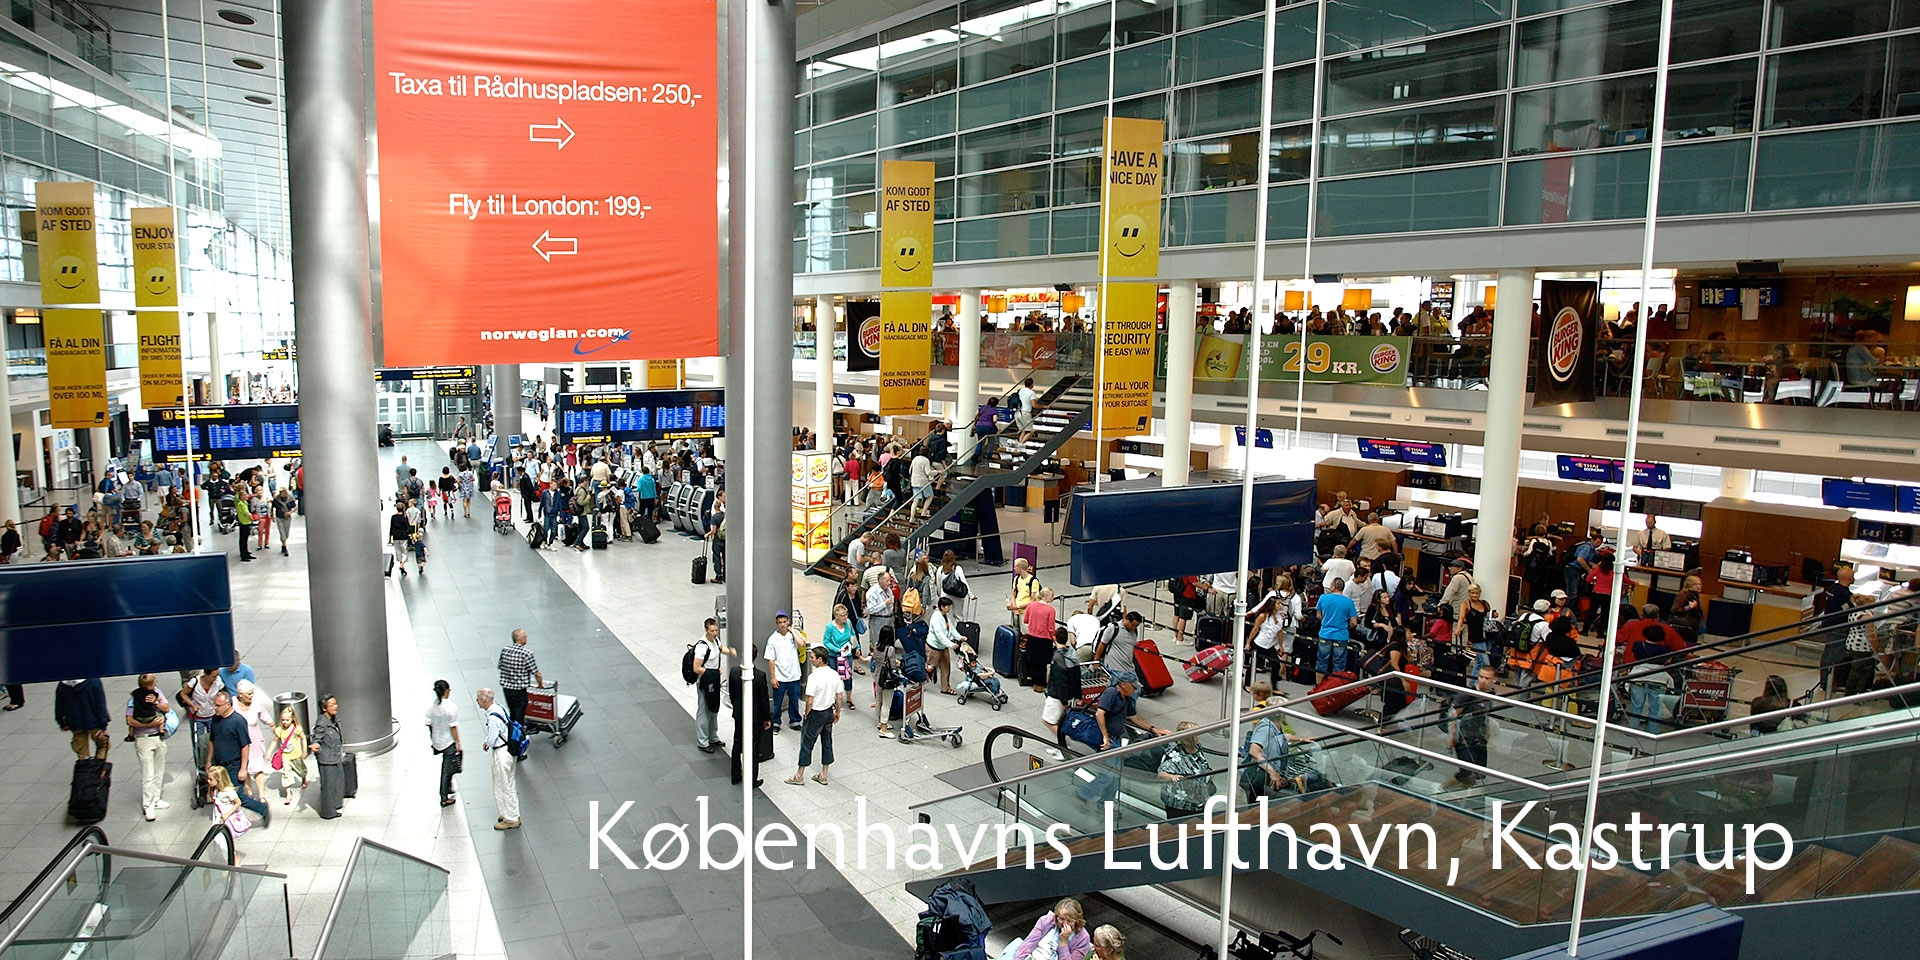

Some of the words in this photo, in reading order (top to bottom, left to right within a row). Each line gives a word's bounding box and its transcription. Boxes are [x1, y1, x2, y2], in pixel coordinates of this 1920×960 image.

[388, 72, 443, 96] Taxa
[448, 74, 467, 97] til
[474, 74, 648, 104] Rådhuspladsen:
[651, 83, 703, 108] 250,-
[1110, 150, 1145, 167] HAVE
[1148, 152, 1158, 168] A
[1109, 171, 1133, 184] NICE
[1135, 172, 1158, 185] DAY
[886, 186, 906, 196] KOM
[907, 186, 931, 196] GODT
[40, 207, 63, 216] KOM
[65, 207, 91, 216] GODT
[449, 194, 481, 220] Fly
[487, 194, 505, 216] til
[512, 195, 599, 216] London:
[605, 196, 652, 219] 199,-
[886, 200, 900, 211] AF
[902, 200, 930, 212] STED
[42, 220, 57, 231] AF
[60, 219, 92, 231] STED
[135, 227, 174, 239] ENJOY
[135, 242, 157, 250] YOUR
[883, 321, 896, 333] FÅ
[898, 322, 910, 333] AL
[912, 322, 928, 333] DIN
[1117, 321, 1152, 330] THROUGH
[862, 325, 881, 339] BURGE
[1553, 322, 1579, 347] BURGER
[49, 337, 63, 348] FÅ
[65, 338, 79, 348] AL
[81, 338, 100, 348] DIN
[141, 335, 180, 346] FLIGHT
[863, 333, 881, 348] KIN
[1115, 348, 1133, 356] EASY
[1135, 347, 1151, 356] WAY
[1373, 350, 1396, 360] BURGER
[1552, 333, 1579, 366] KING
[1282, 341, 1332, 374] 29
[1332, 361, 1363, 375] KR.
[1374, 355, 1397, 366] KING
[883, 378, 927, 387] GENSTANDE
[1114, 382, 1128, 390] ALL
[1129, 381, 1149, 390] YOUR
[53, 392, 75, 400] OVER
[76, 391, 90, 399] 100
[92, 391, 104, 399] ML
[1121, 400, 1148, 408] SUITCASE
[1860, 528, 1882, 538] SAS
